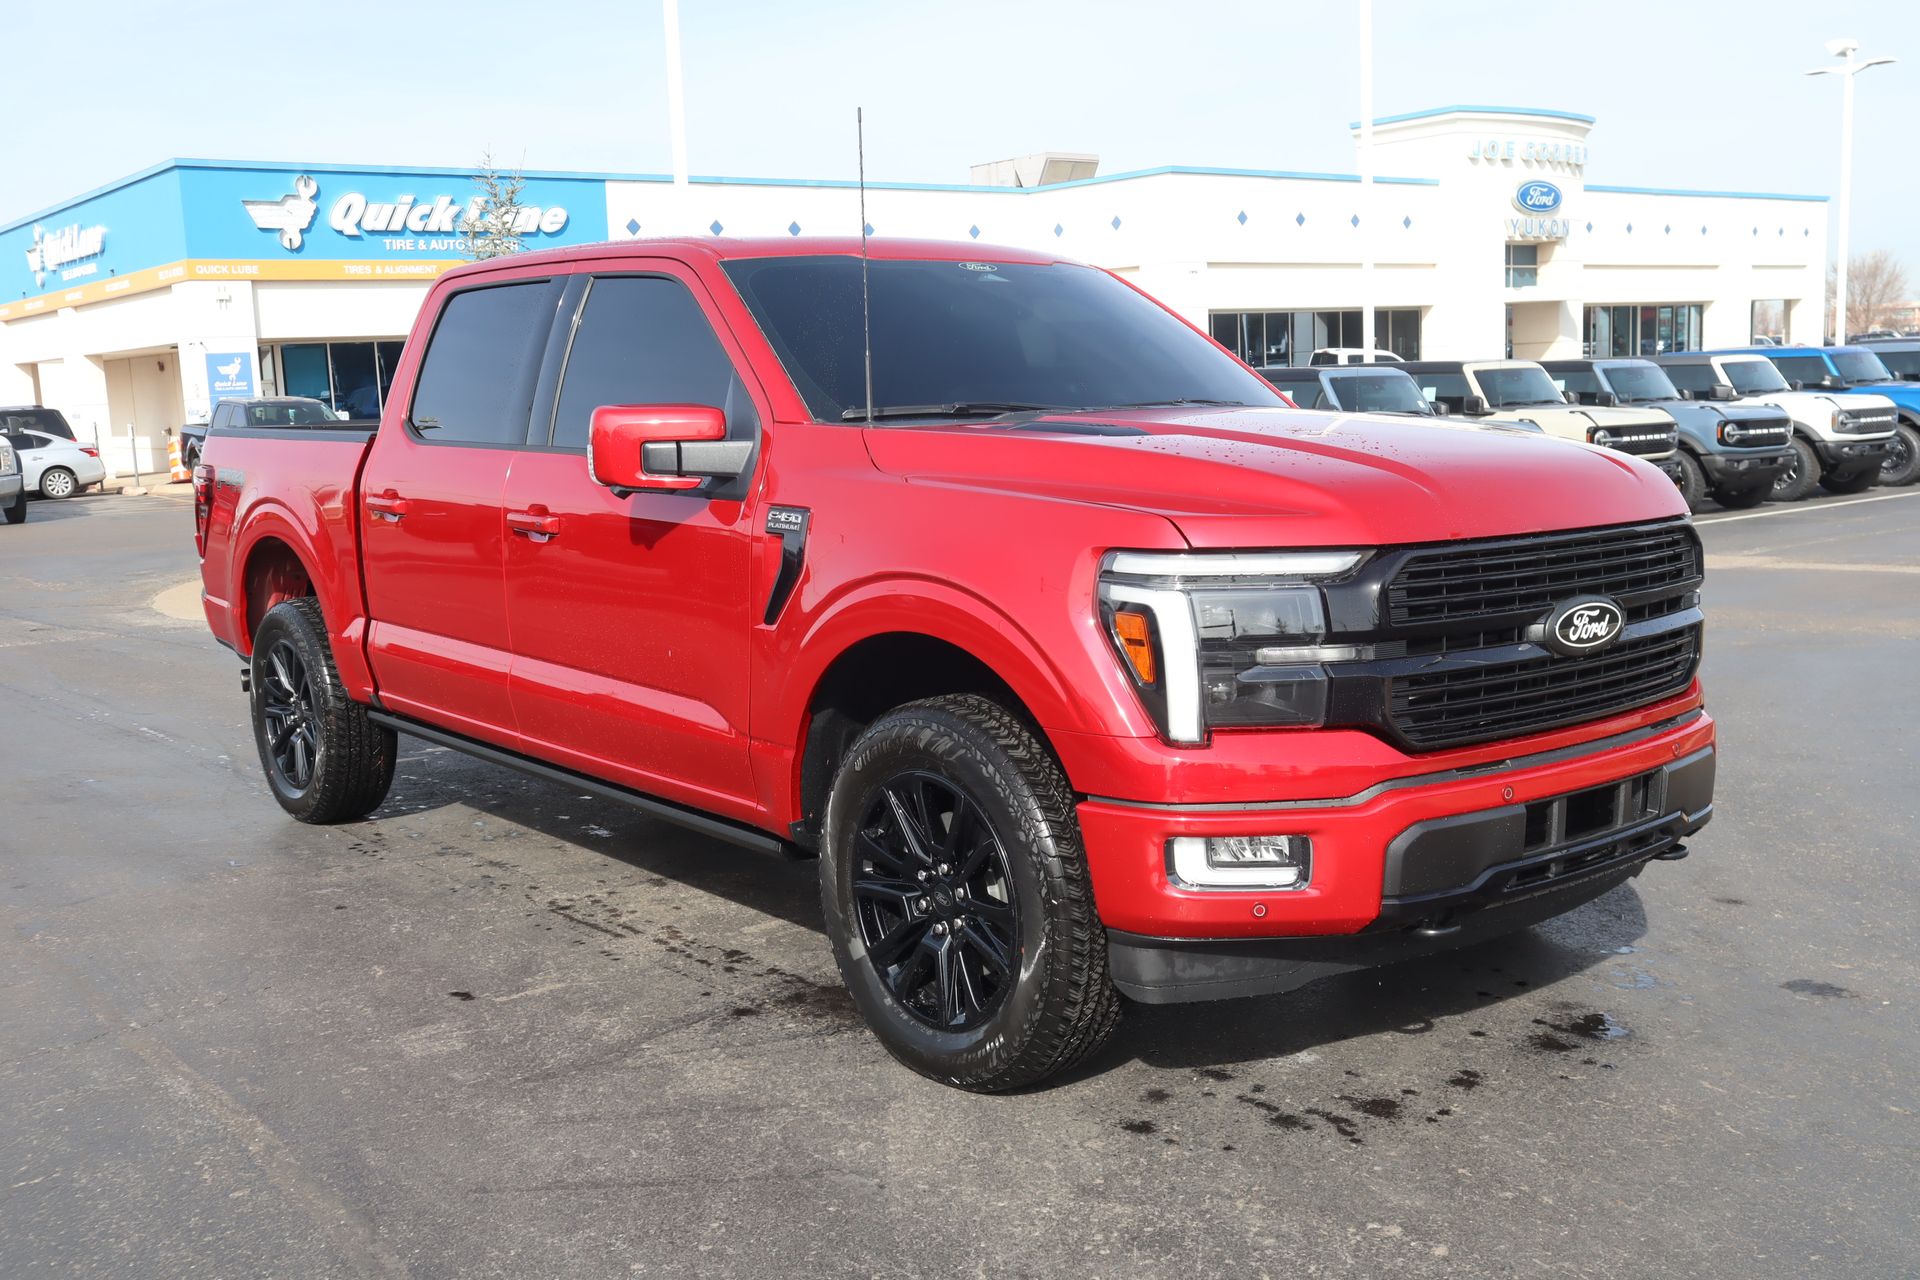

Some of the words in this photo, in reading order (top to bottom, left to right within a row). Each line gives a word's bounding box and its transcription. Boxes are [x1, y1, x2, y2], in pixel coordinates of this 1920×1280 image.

[1473, 140, 1516, 160] JOE
[1526, 185, 1555, 206] Ford
[329, 192, 460, 235] Quick
[1510, 218, 1570, 238] YUKON
[384, 239, 415, 251] TIRE
[418, 239, 428, 251] &
[430, 239, 466, 251] AUTO
[196, 264, 228, 275] QUICK
[231, 264, 259, 275] LUBE
[343, 264, 371, 275] TIRES
[375, 264, 382, 275] &
[384, 264, 437, 275] ALIGNMENT
[1569, 609, 1610, 641] Ford
